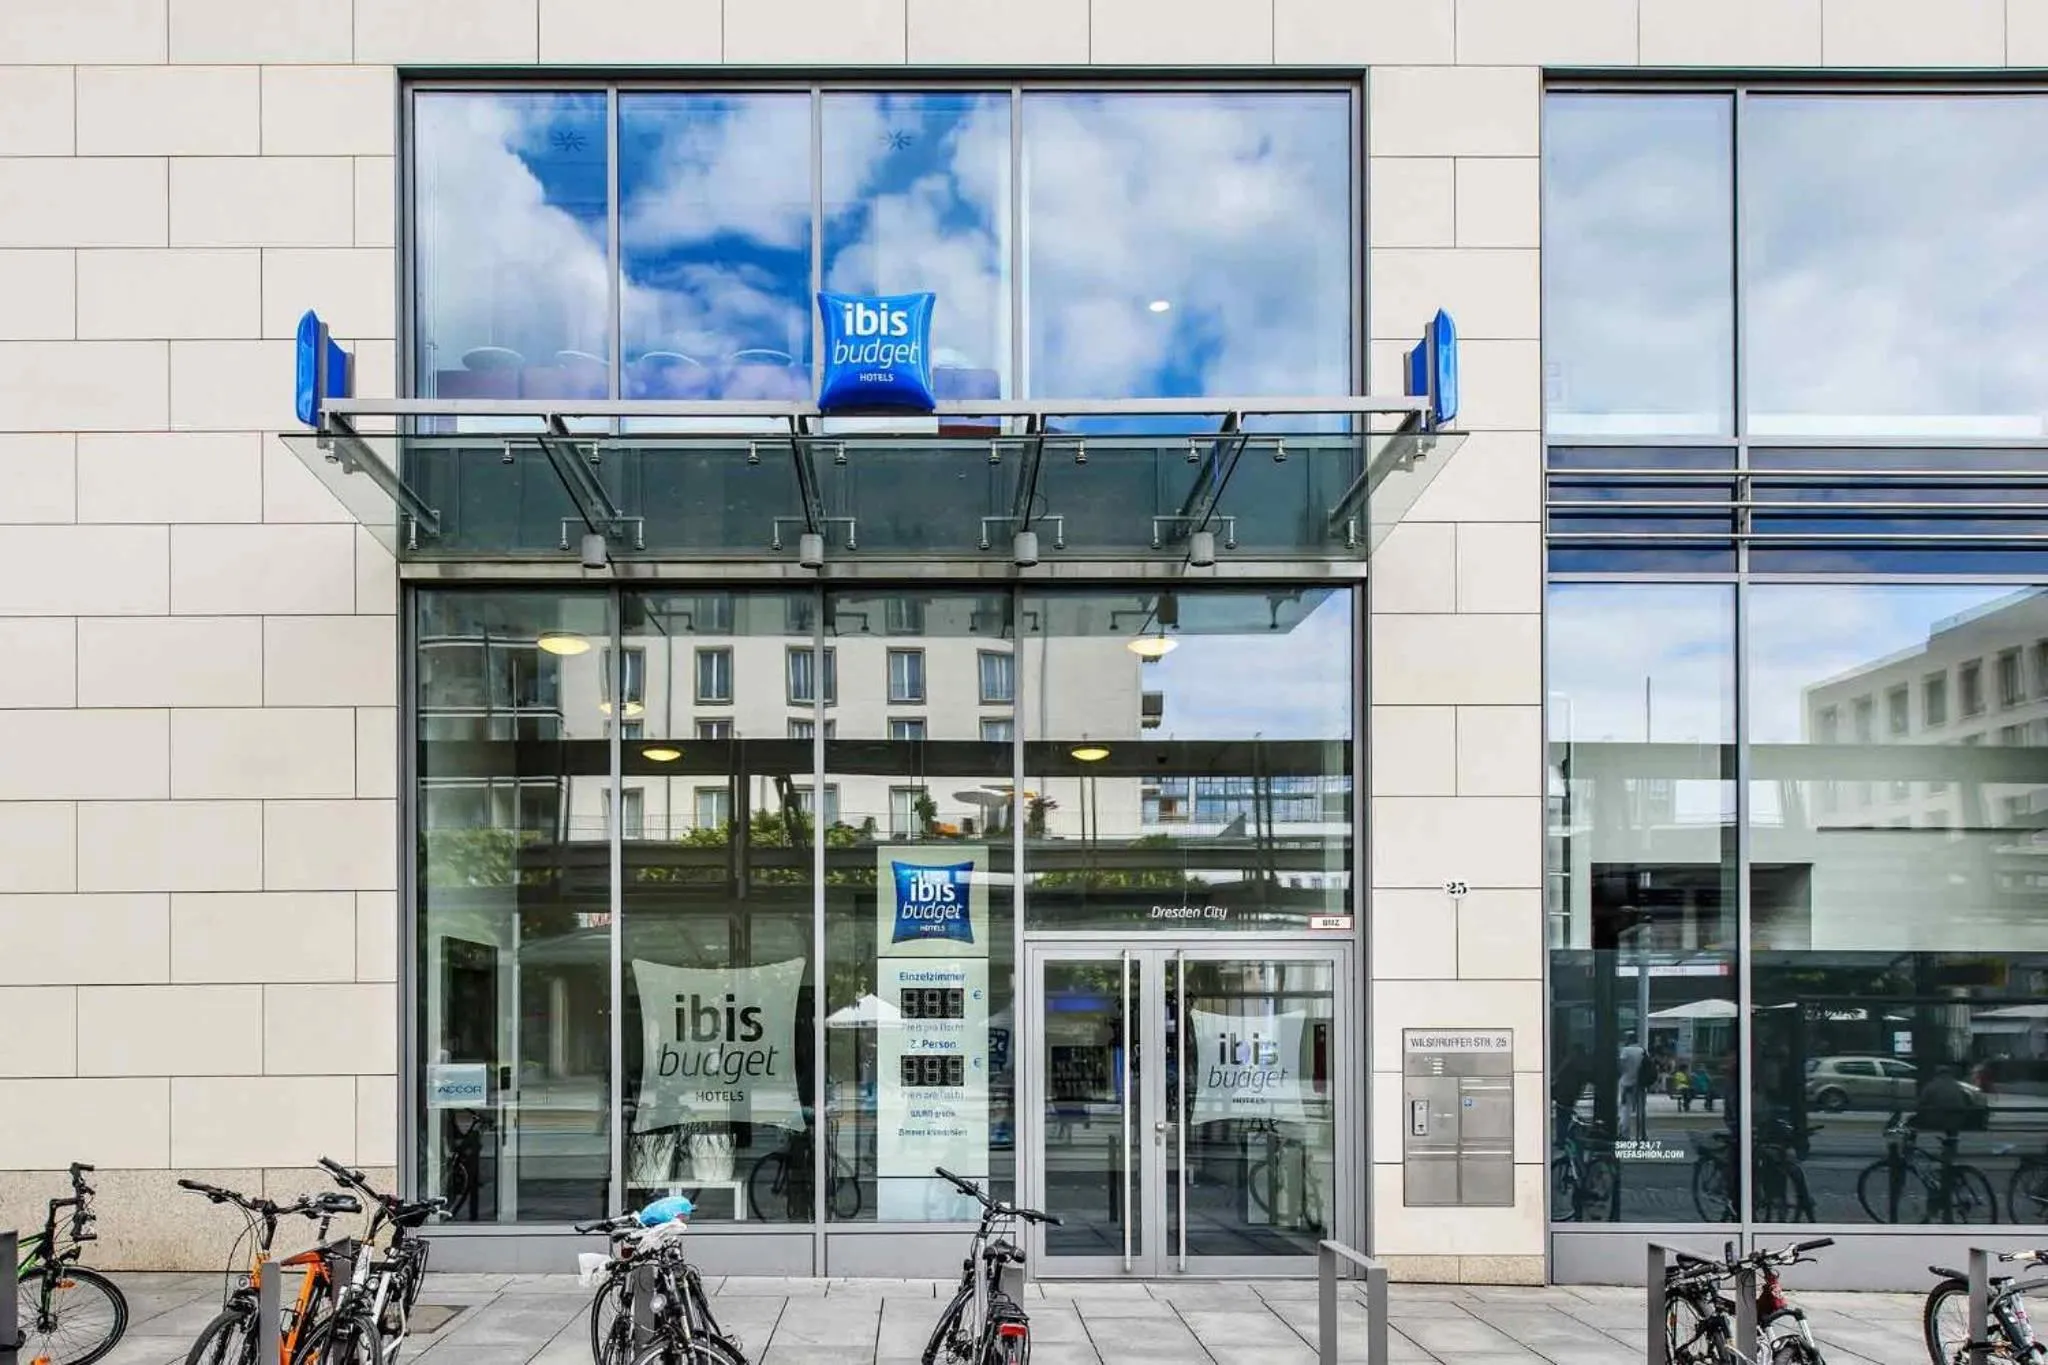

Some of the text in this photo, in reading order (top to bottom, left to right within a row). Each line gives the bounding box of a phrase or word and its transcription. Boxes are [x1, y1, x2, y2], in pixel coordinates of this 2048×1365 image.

[844, 302, 909, 337] ibis
[833, 338, 920, 370] budget
[859, 372, 894, 382] HOTELS
[910, 876, 956, 902] ibis
[1446, 881, 1467, 894] 25
[901, 902, 964, 924] budget
[1151, 905, 1228, 920] Dresden City
[919, 924, 946, 932] HOTELS
[899, 972, 966, 982] Einzelzimmer
[674, 993, 764, 1043] ibis
[921, 1039, 957, 1049] Person
[1495, 1037, 1507, 1047] 25
[1219, 1032, 1279, 1066] ibis
[658, 1042, 780, 1085] budget
[1208, 1065, 1289, 1094] budget
[438, 1085, 482, 1094] ACCOR
[695, 1091, 745, 1102] HOTELS
[1614, 1140, 1662, 1150] SHOP 24/7
[1614, 1150, 1685, 1159] WEFASHION.COM
